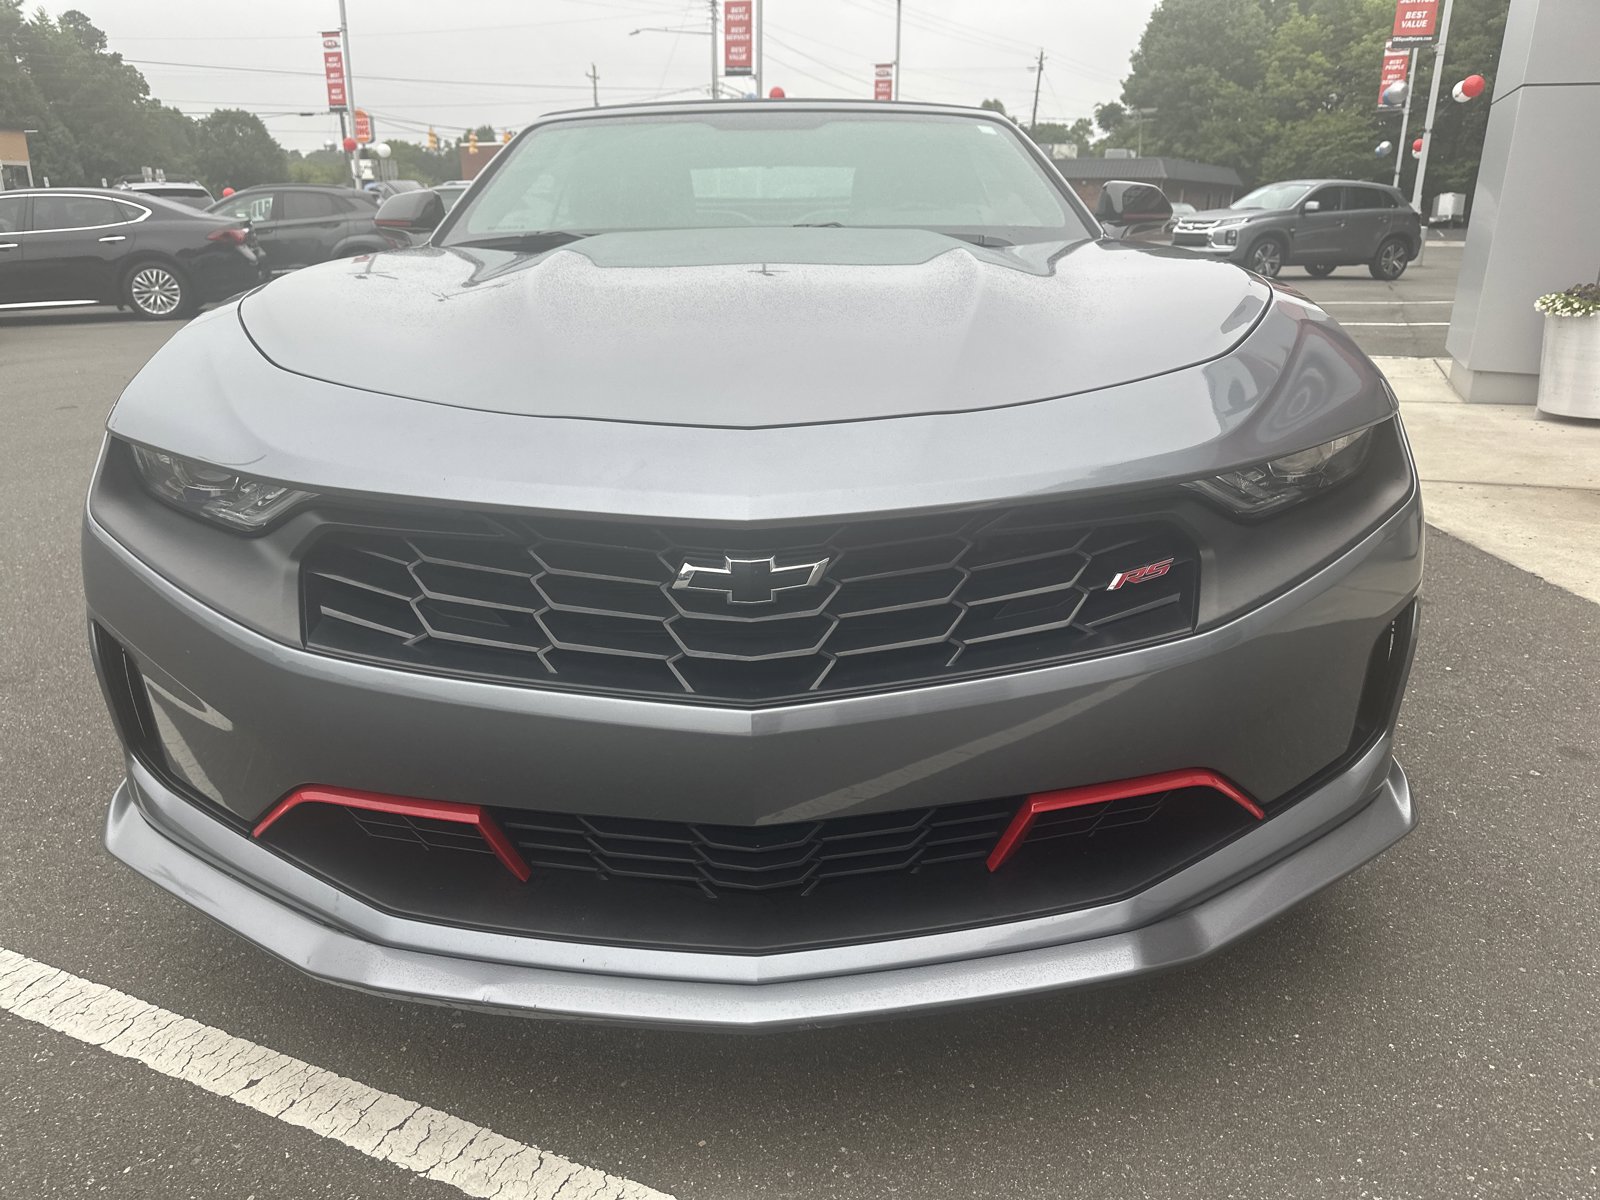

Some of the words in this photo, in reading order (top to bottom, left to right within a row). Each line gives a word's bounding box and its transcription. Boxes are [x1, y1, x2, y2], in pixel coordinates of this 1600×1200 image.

[1405, 11, 1428, 19] BEST
[1401, 20, 1428, 28] VALUE
[1106, 557, 1175, 591] RS
